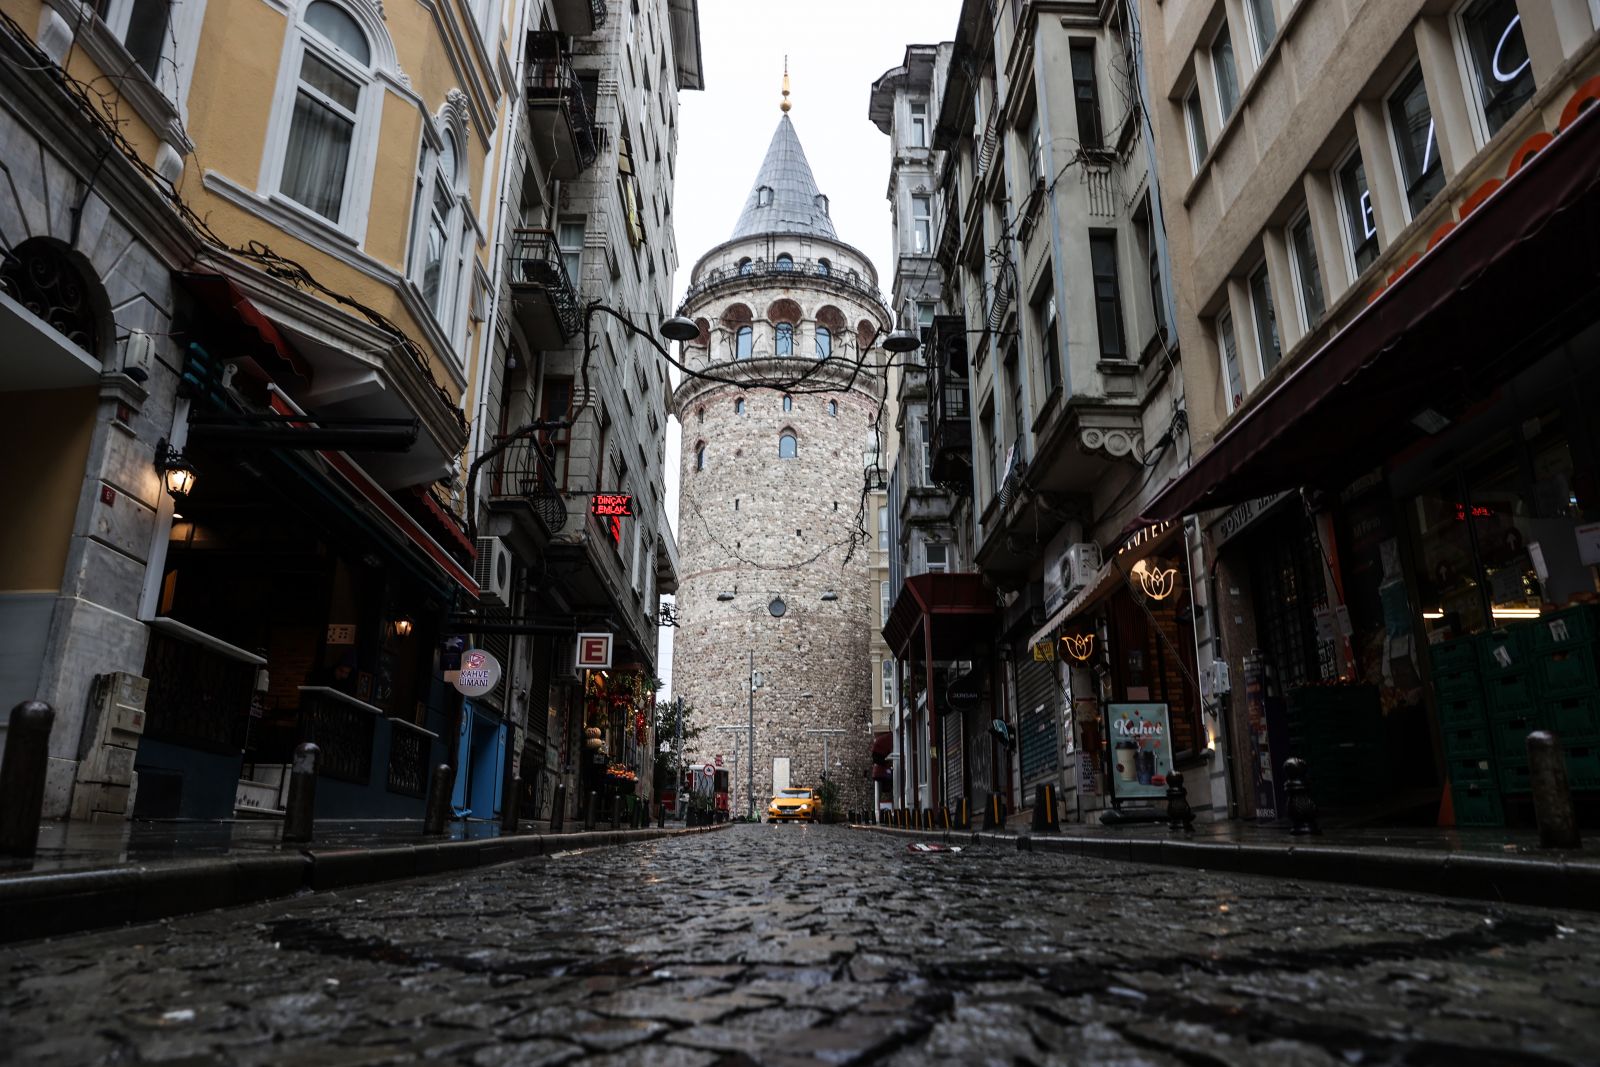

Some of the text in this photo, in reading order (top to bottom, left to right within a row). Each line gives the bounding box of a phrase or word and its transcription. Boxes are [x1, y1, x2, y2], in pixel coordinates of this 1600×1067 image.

[597, 505, 627, 514] EMLAK
[585, 641, 603, 661] E
[461, 670, 488, 678] KAHVE
[1113, 719, 1163, 735] Kahve
